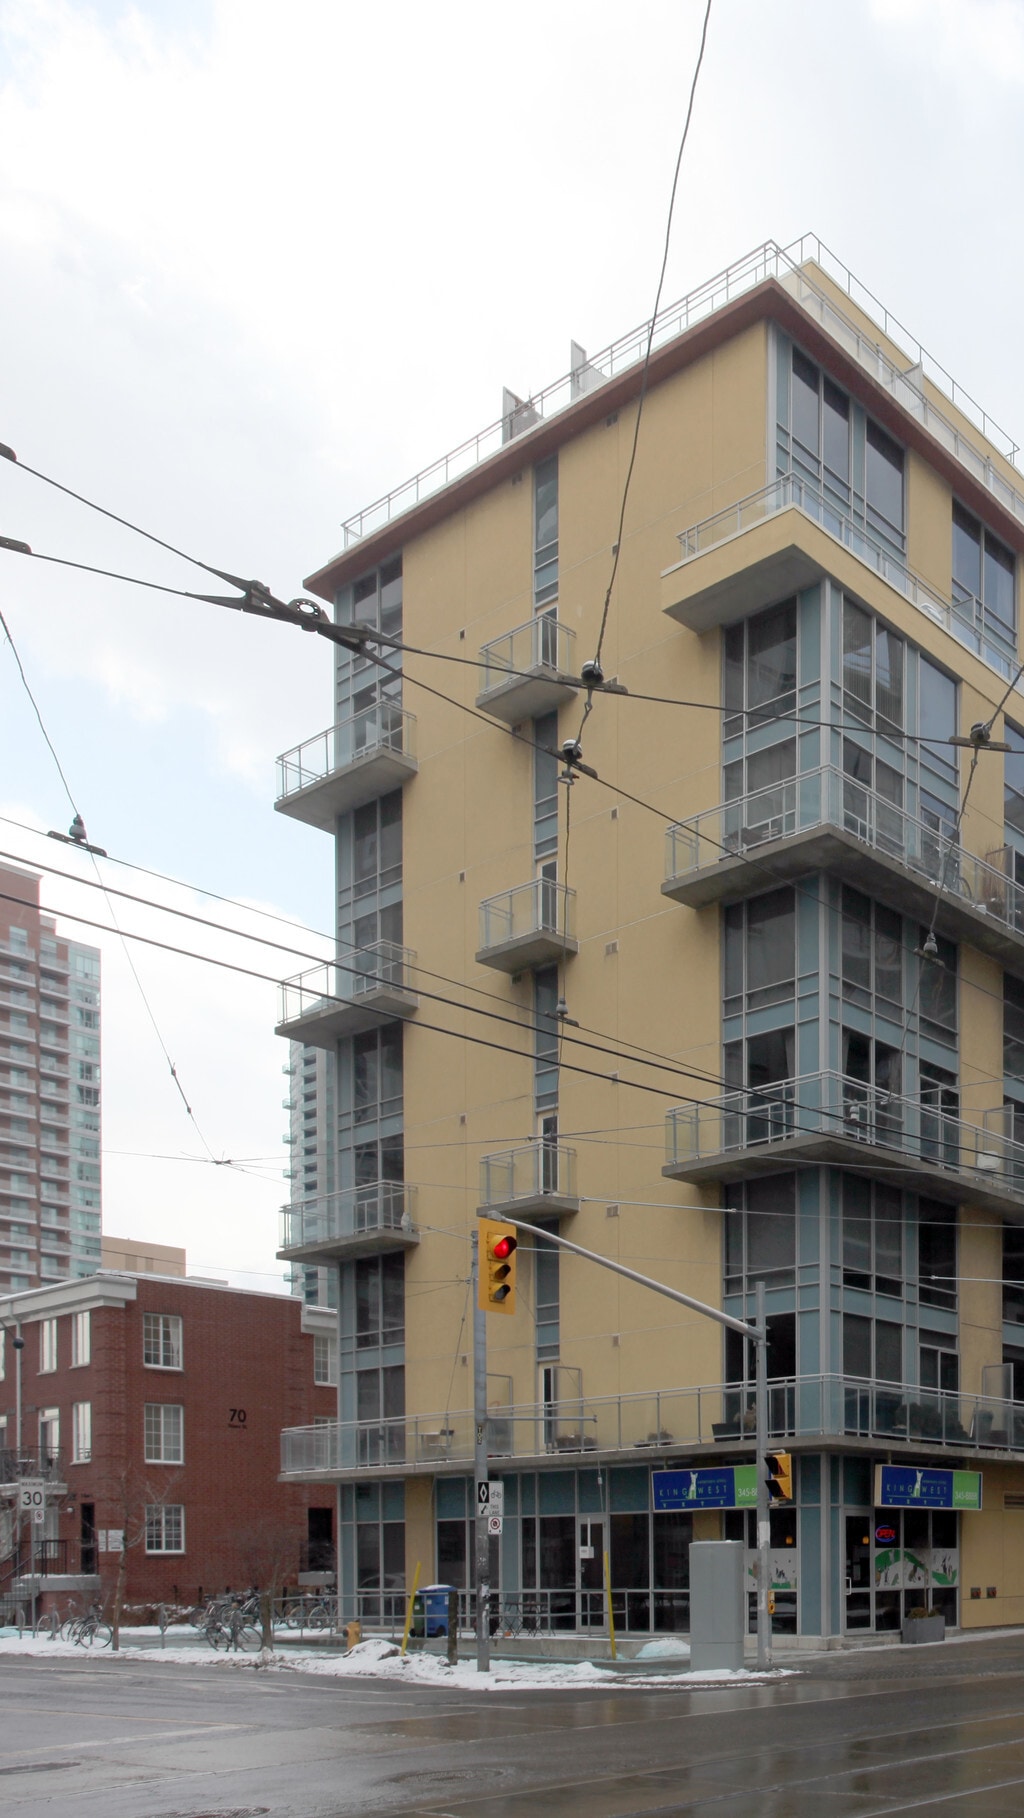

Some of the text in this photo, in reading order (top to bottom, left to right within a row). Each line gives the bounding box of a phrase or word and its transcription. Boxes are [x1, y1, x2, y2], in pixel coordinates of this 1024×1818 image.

[229, 1408, 247, 1423] 70
[659, 1484, 727, 1497] KING WEST
[886, 1484, 947, 1494] KING WEST
[22, 1491, 43, 1506] 30
